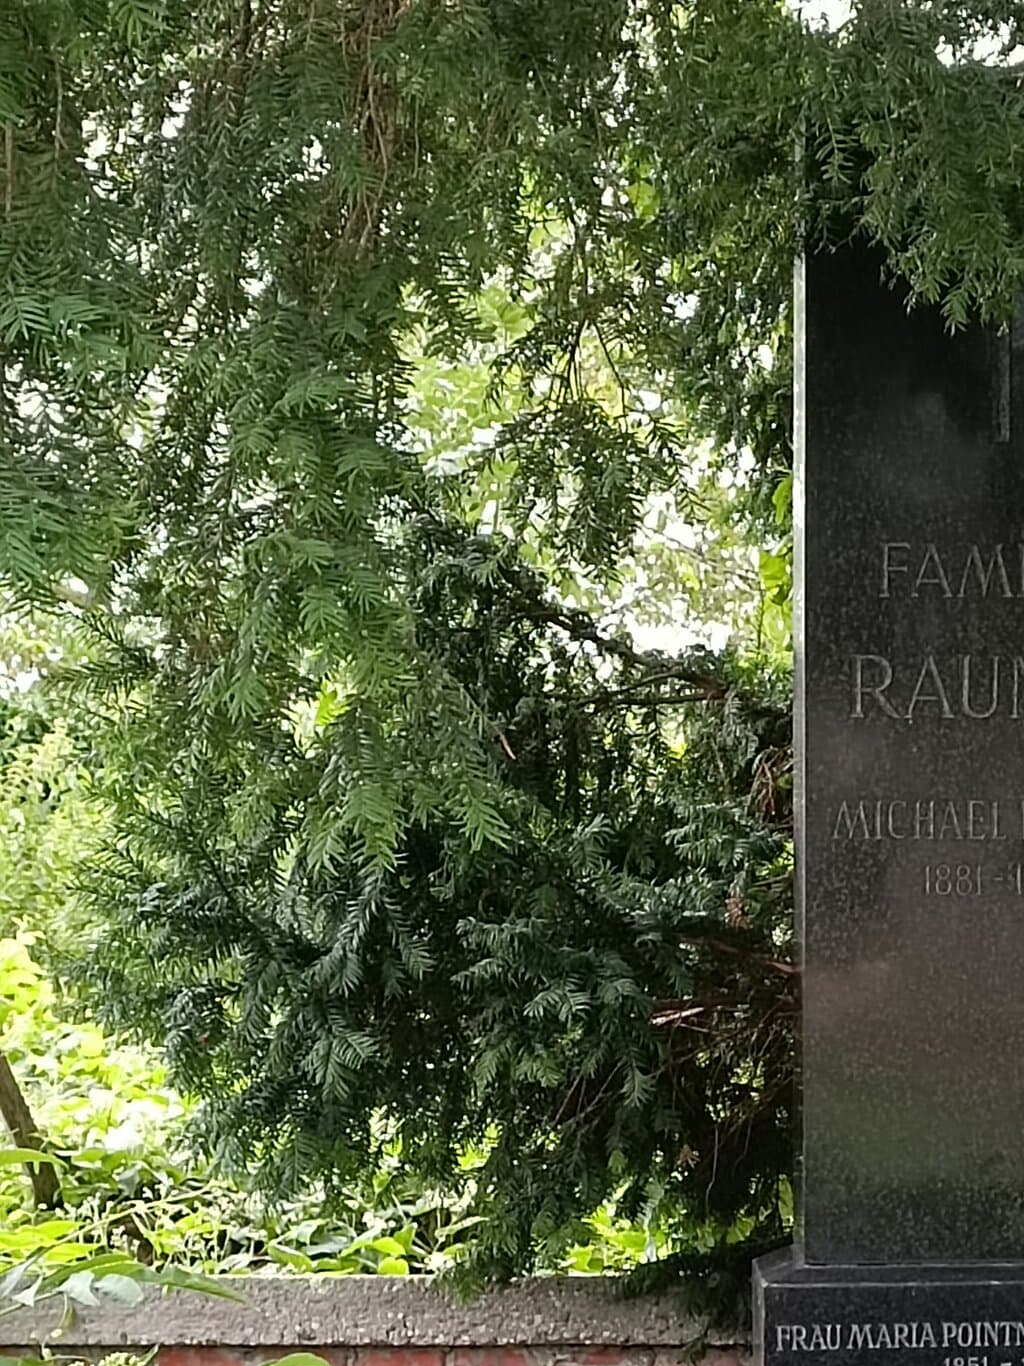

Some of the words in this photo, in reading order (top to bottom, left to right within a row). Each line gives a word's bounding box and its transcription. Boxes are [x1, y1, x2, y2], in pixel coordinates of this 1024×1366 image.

[832, 800, 1007, 840] MICHAEL
[924, 864, 983, 896] 1881
[775, 1324, 841, 1351] FRAU
[846, 1321, 937, 1349] MARIA
